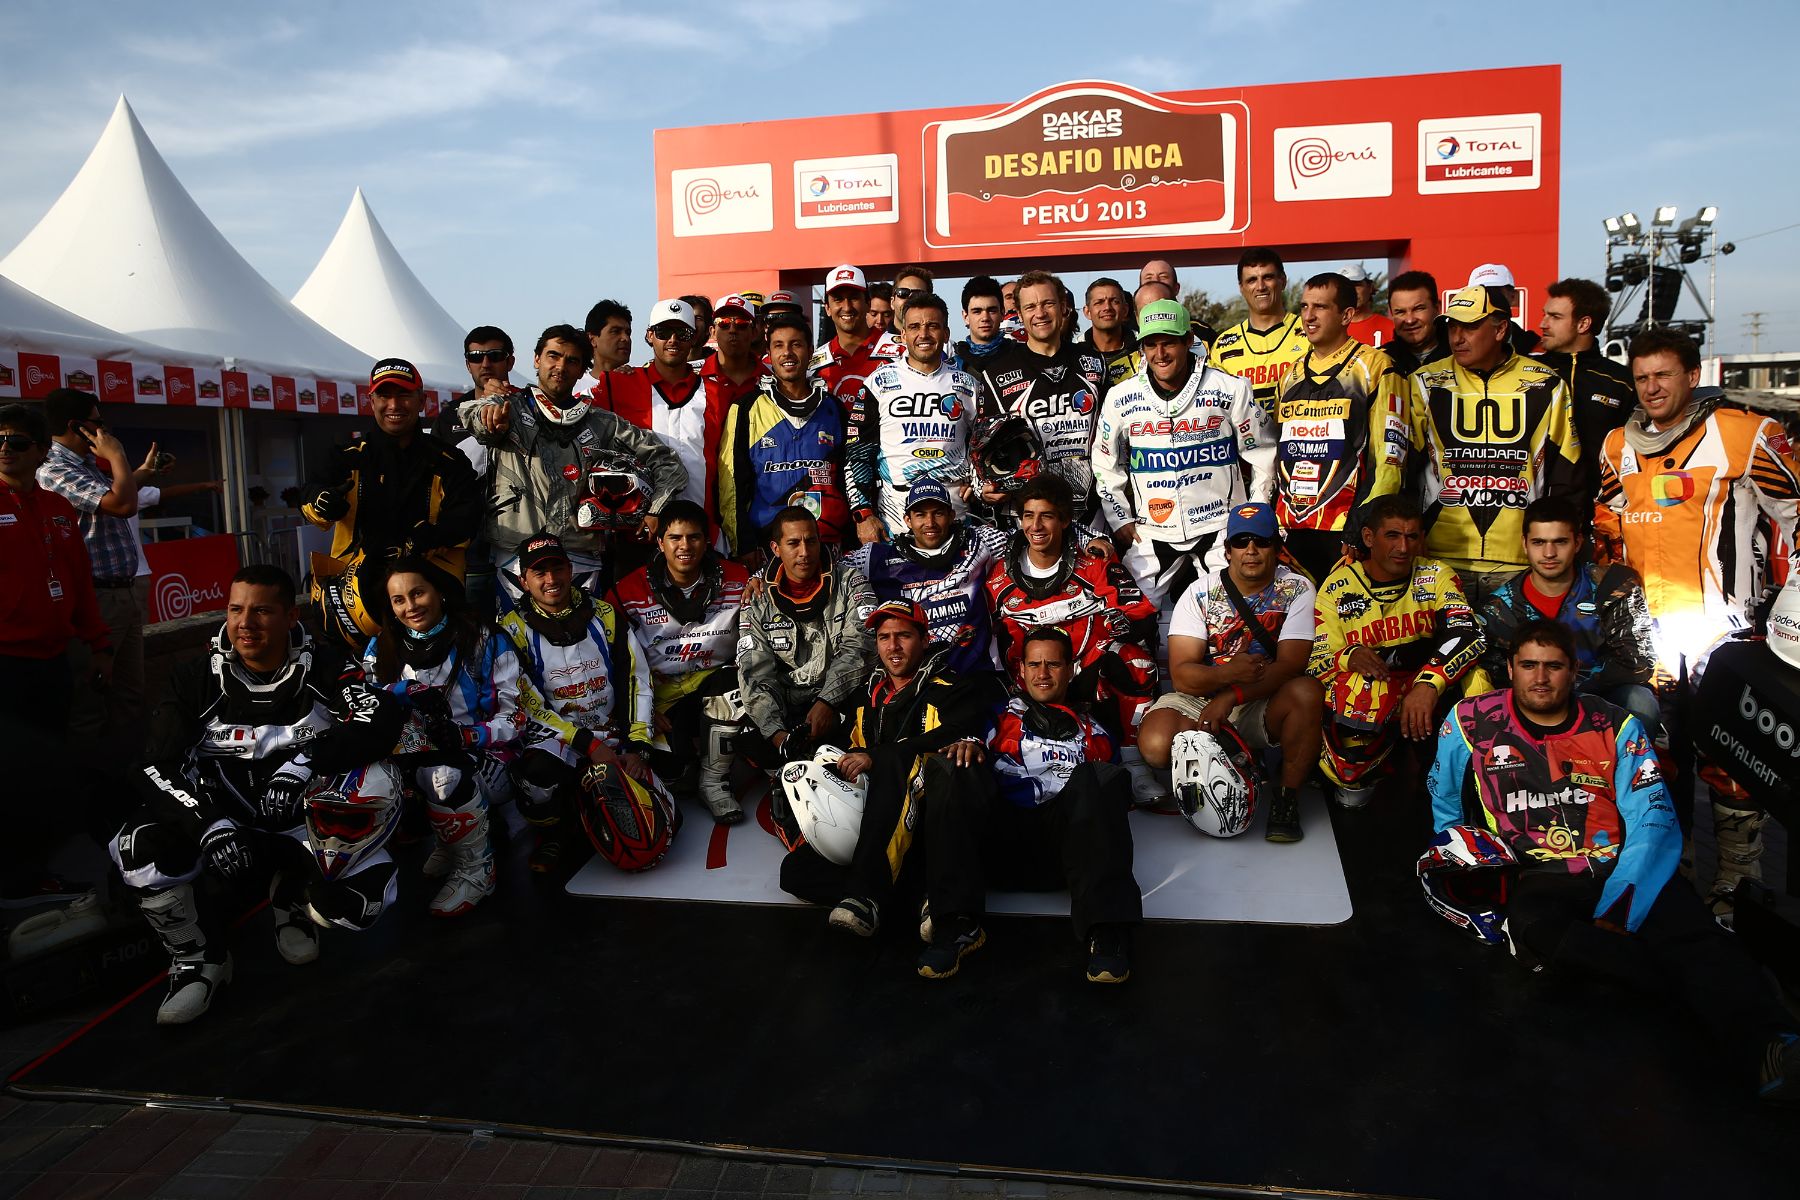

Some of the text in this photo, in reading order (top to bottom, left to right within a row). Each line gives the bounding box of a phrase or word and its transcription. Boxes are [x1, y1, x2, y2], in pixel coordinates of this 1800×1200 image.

[1043, 108, 1123, 128] DAKAR
[1043, 123, 1123, 142] SERIES
[1465, 139, 1522, 153] TOTAL
[984, 143, 1183, 179] DESAFIO INCA
[1288, 137, 1377, 190] Perú
[1444, 163, 1513, 178] Lubricantes
[834, 177, 882, 190] TOTAL
[685, 178, 760, 226] Perú
[817, 199, 876, 214] Lubricantes
[1022, 198, 1147, 225] PERÚ 2013
[996, 369, 1023, 387] OBUT
[1120, 391, 1145, 406] YAMAH
[1177, 374, 1200, 406] movistar
[889, 393, 940, 417] elf
[1028, 392, 1070, 419] elf
[1281, 403, 1343, 419] El Comercio
[902, 422, 956, 439] YAMAHA
[1053, 420, 1089, 432] YAMAHA
[1129, 415, 1226, 437] CASALE
[1290, 422, 1330, 437] nextel
[1045, 437, 1088, 449] KENNY
[1297, 443, 1329, 454] YAMAHA
[918, 448, 940, 457] OBUT
[1147, 443, 1231, 469] movistar
[1444, 448, 1528, 461] STANDARD
[764, 460, 824, 474] lenovo
[1147, 472, 1213, 490] GOODYEAR
[1444, 475, 1529, 491] CORDOBA
[1149, 501, 1173, 511] FUTURO
[1194, 499, 1224, 515] YAMAHA
[1457, 490, 1529, 509] MOTOS
[1624, 511, 1663, 524] terra
[1416, 576, 1436, 585] Castr
[156, 572, 224, 622] Perú
[329, 585, 359, 635] can-am
[646, 609, 667, 618] LIQUI
[925, 601, 967, 620] YAMAHA
[647, 616, 668, 625] MOLY
[1444, 639, 1487, 679] SUZUKI
[1739, 683, 1800, 758] boo
[1710, 723, 1781, 788] NOVALIGHT
